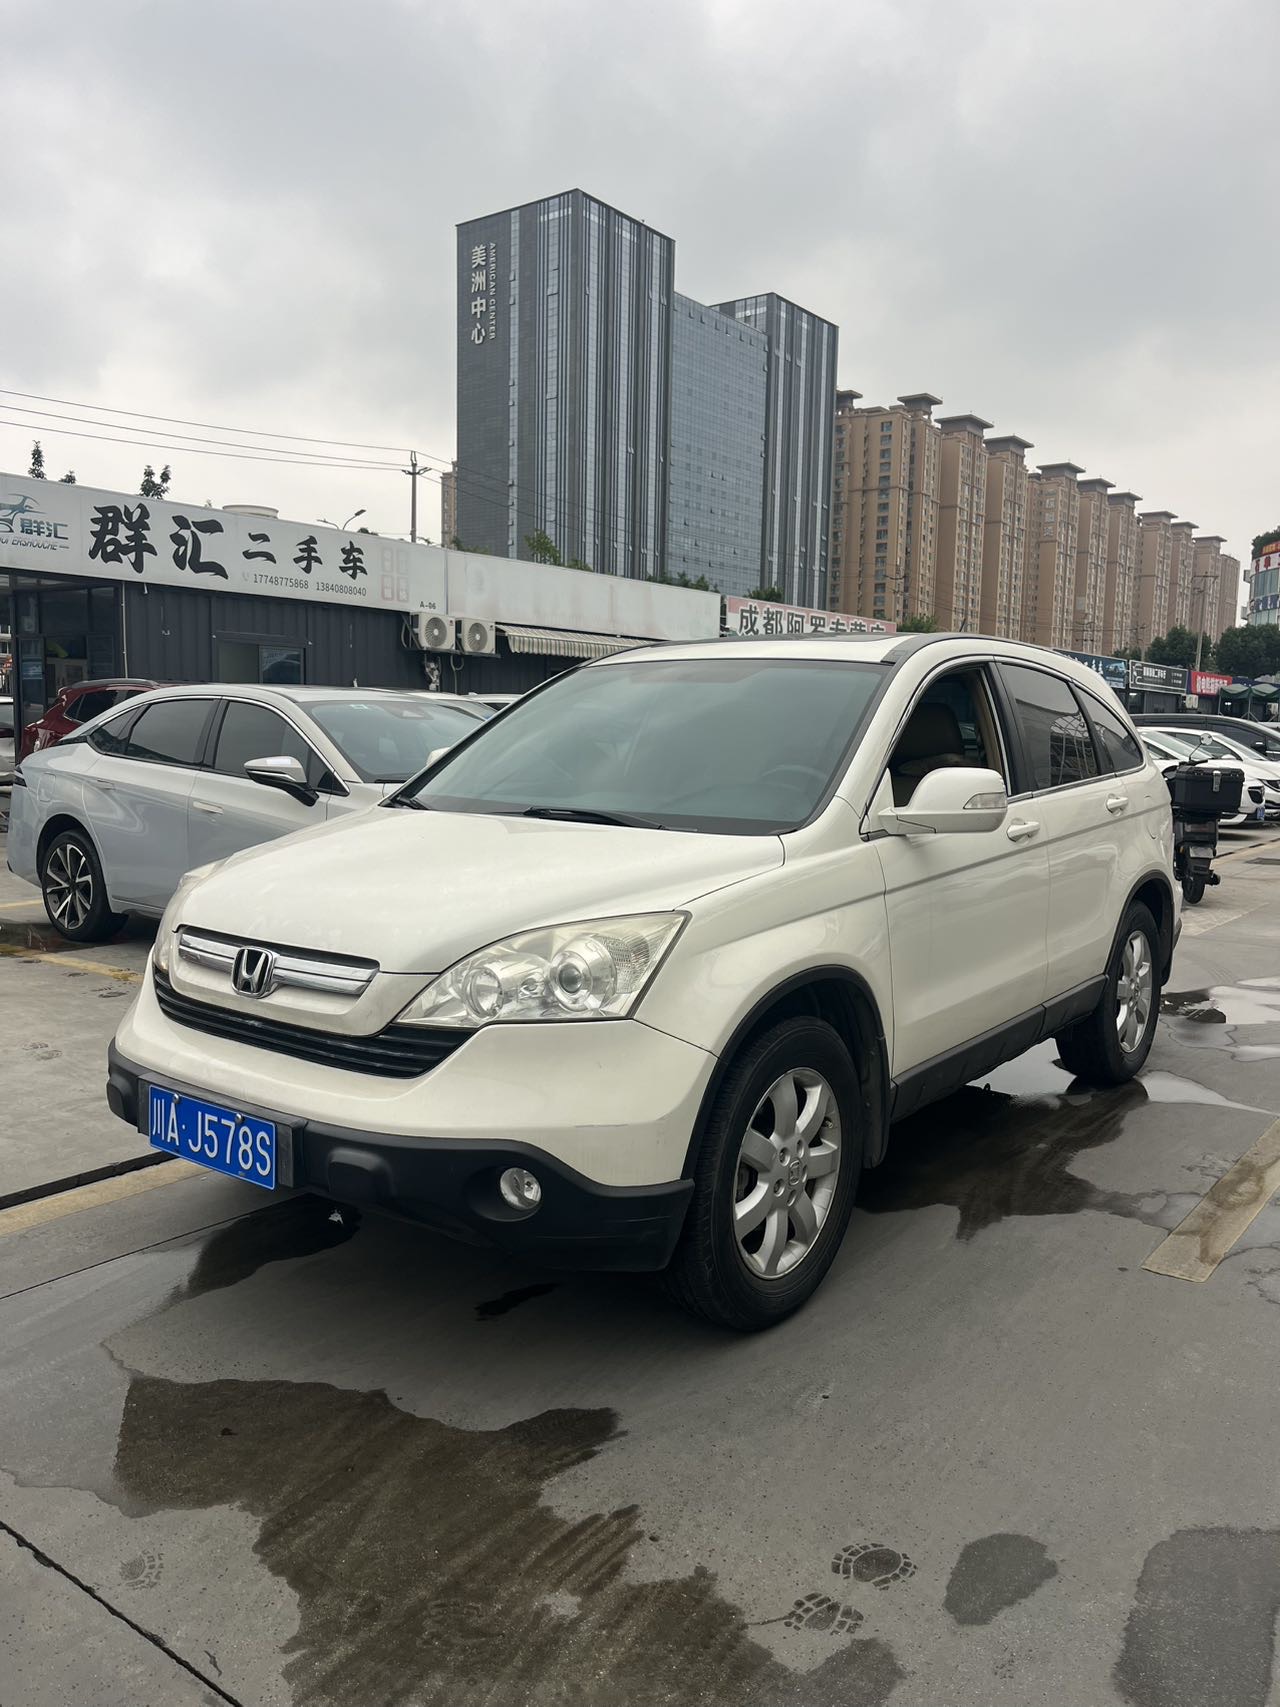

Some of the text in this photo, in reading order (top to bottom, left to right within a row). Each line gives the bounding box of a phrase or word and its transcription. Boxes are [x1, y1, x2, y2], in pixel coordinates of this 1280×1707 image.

[489, 242, 497, 296] AMERICAN
[471, 244, 487, 345] 美洲中心
[20, 517, 69, 540] 群汇
[253, 573, 367, 597] 17748775868 13840808040
[420, 600, 436, 610] A-06
